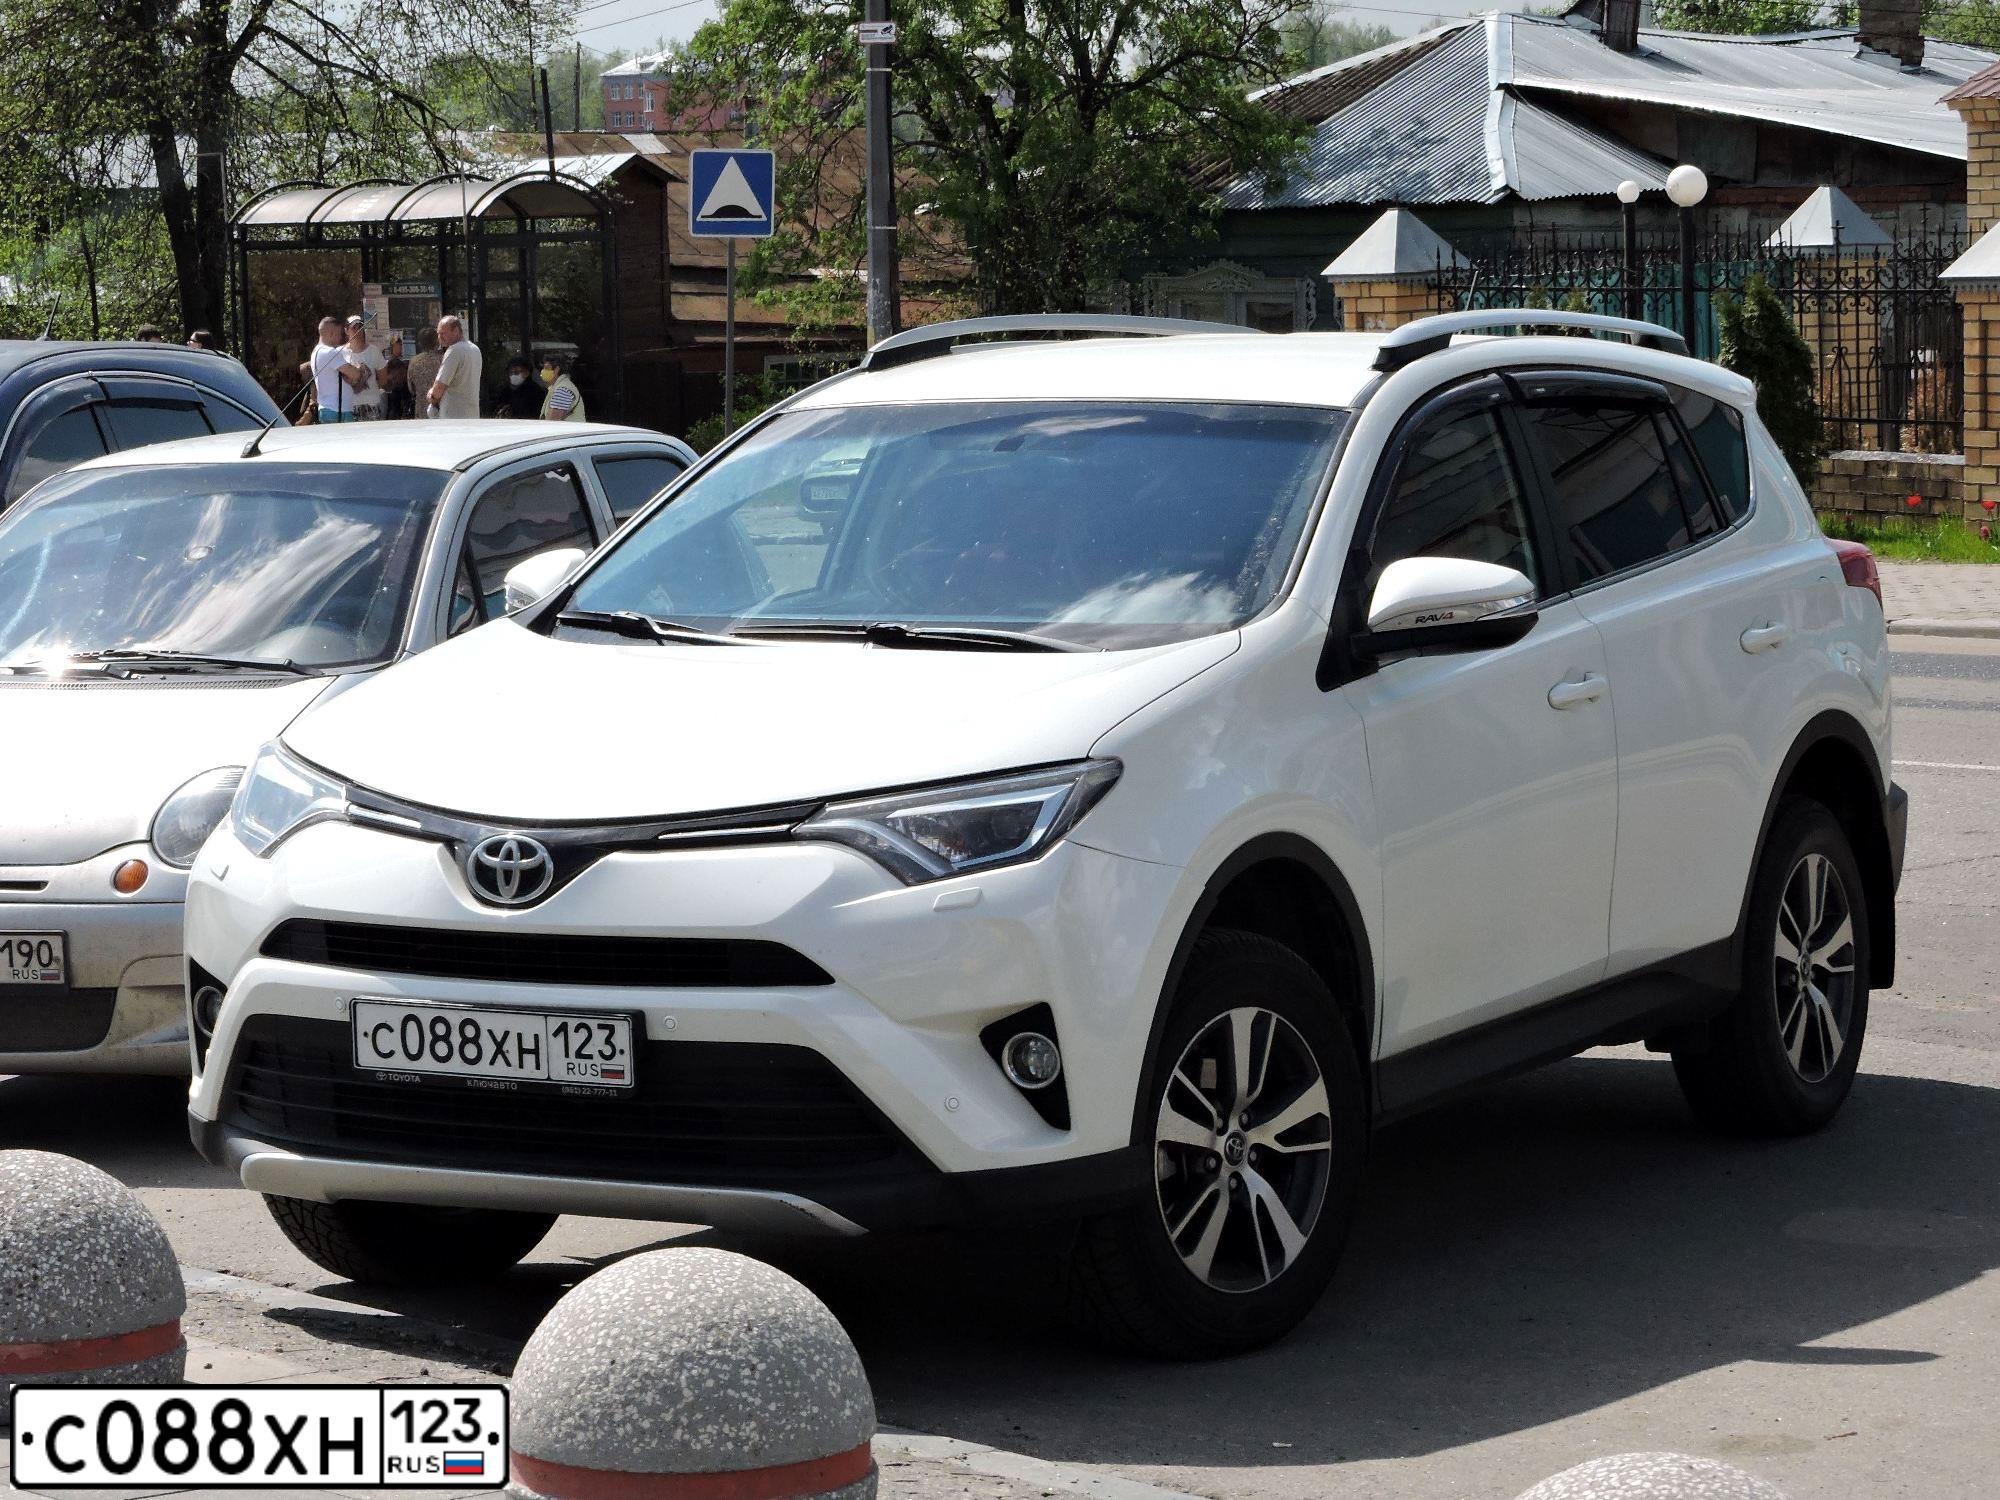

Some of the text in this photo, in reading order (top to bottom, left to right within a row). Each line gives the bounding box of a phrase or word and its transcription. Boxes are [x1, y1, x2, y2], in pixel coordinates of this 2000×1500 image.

[1415, 611, 1456, 625] RAV4
[0, 939, 53, 968] 190
[12, 969, 39, 980] RUS
[552, 1021, 617, 1061] 123
[566, 1062, 599, 1077] RUS
[388, 1072, 421, 1083] TOYOTA
